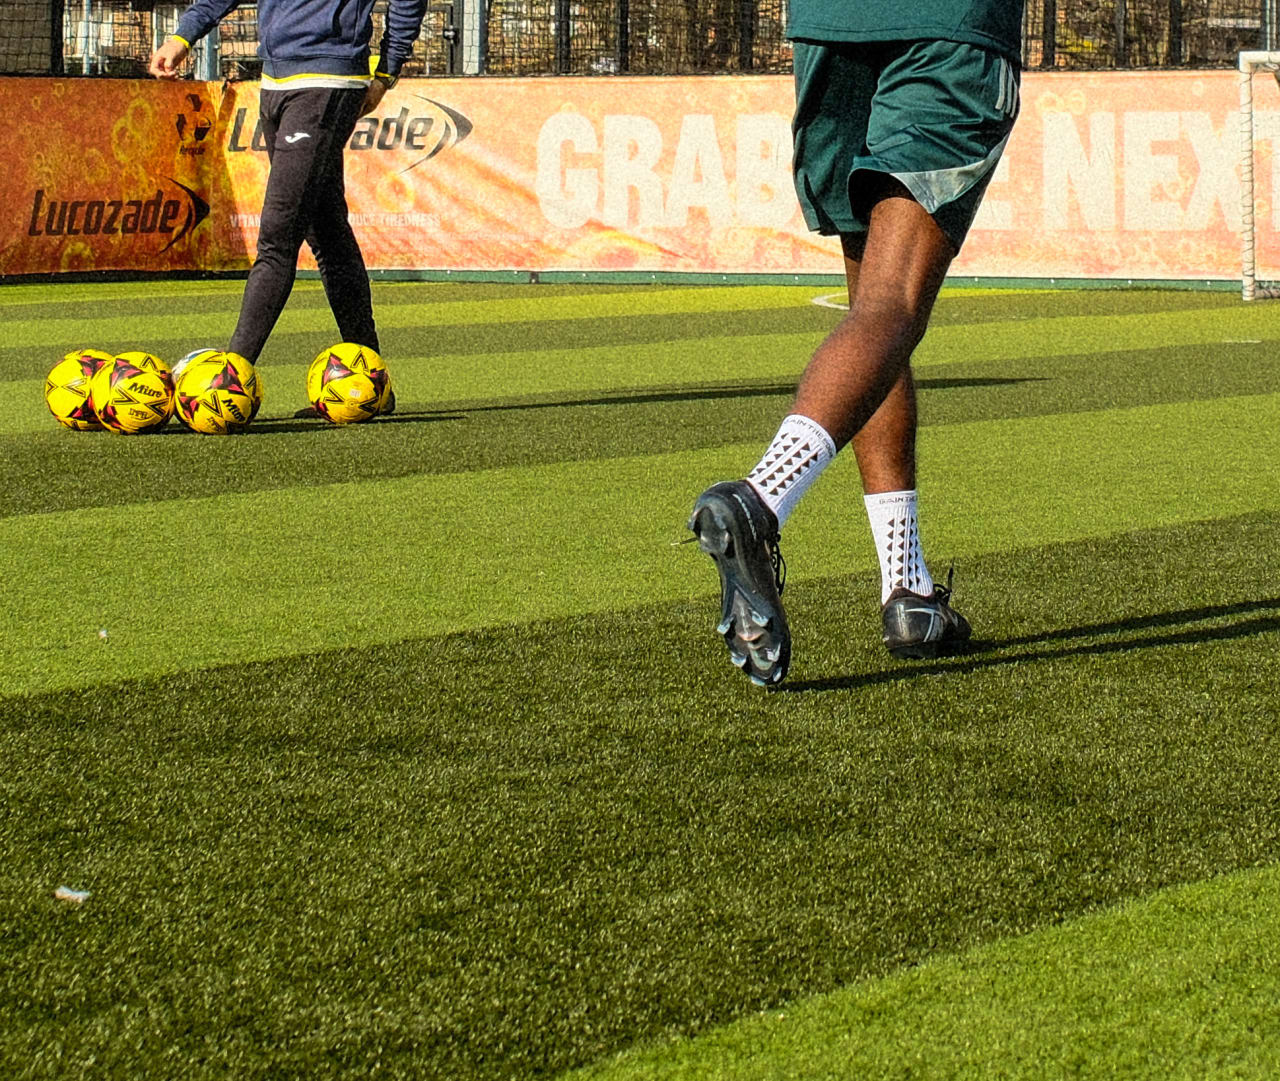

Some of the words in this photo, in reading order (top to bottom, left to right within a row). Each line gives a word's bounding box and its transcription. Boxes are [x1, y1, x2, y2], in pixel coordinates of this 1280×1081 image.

[227, 106, 434, 153] Luade
[535, 110, 796, 231] GRAB
[28, 189, 181, 237] Lucozade
[128, 382, 163, 398] Mitre
